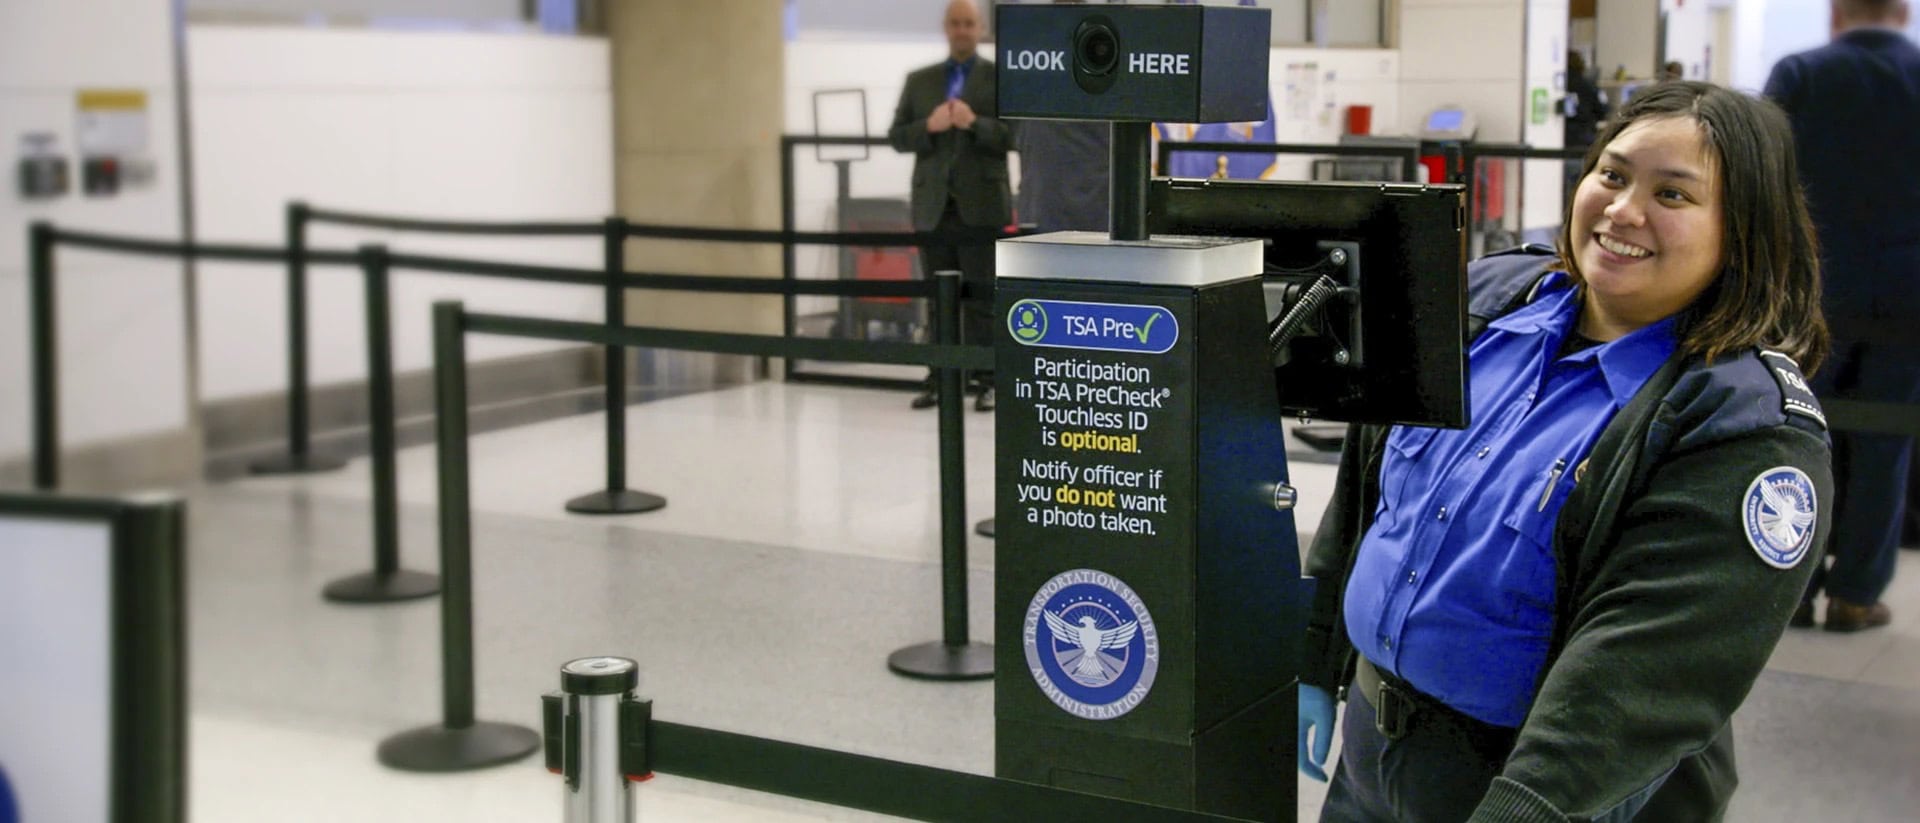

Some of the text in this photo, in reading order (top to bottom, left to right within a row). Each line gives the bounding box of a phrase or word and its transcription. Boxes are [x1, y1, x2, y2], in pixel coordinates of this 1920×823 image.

[1007, 50, 1190, 75] LOOK HERE
[1062, 315, 1099, 337] TSA
[1034, 356, 1150, 384] Participation
[1015, 378, 1032, 398] in
[1036, 380, 1072, 401] TSA
[1035, 404, 1149, 431] Touchless ID
[1042, 426, 1142, 454] is optional.
[1022, 458, 1164, 490] Notify officer if
[1017, 483, 1167, 514] you do not want
[1027, 505, 1157, 536] a photo taken.
[1026, 570, 1157, 662] TRANSPORTATION SECURITY
[1032, 667, 1148, 719] ADMINISTRATION
